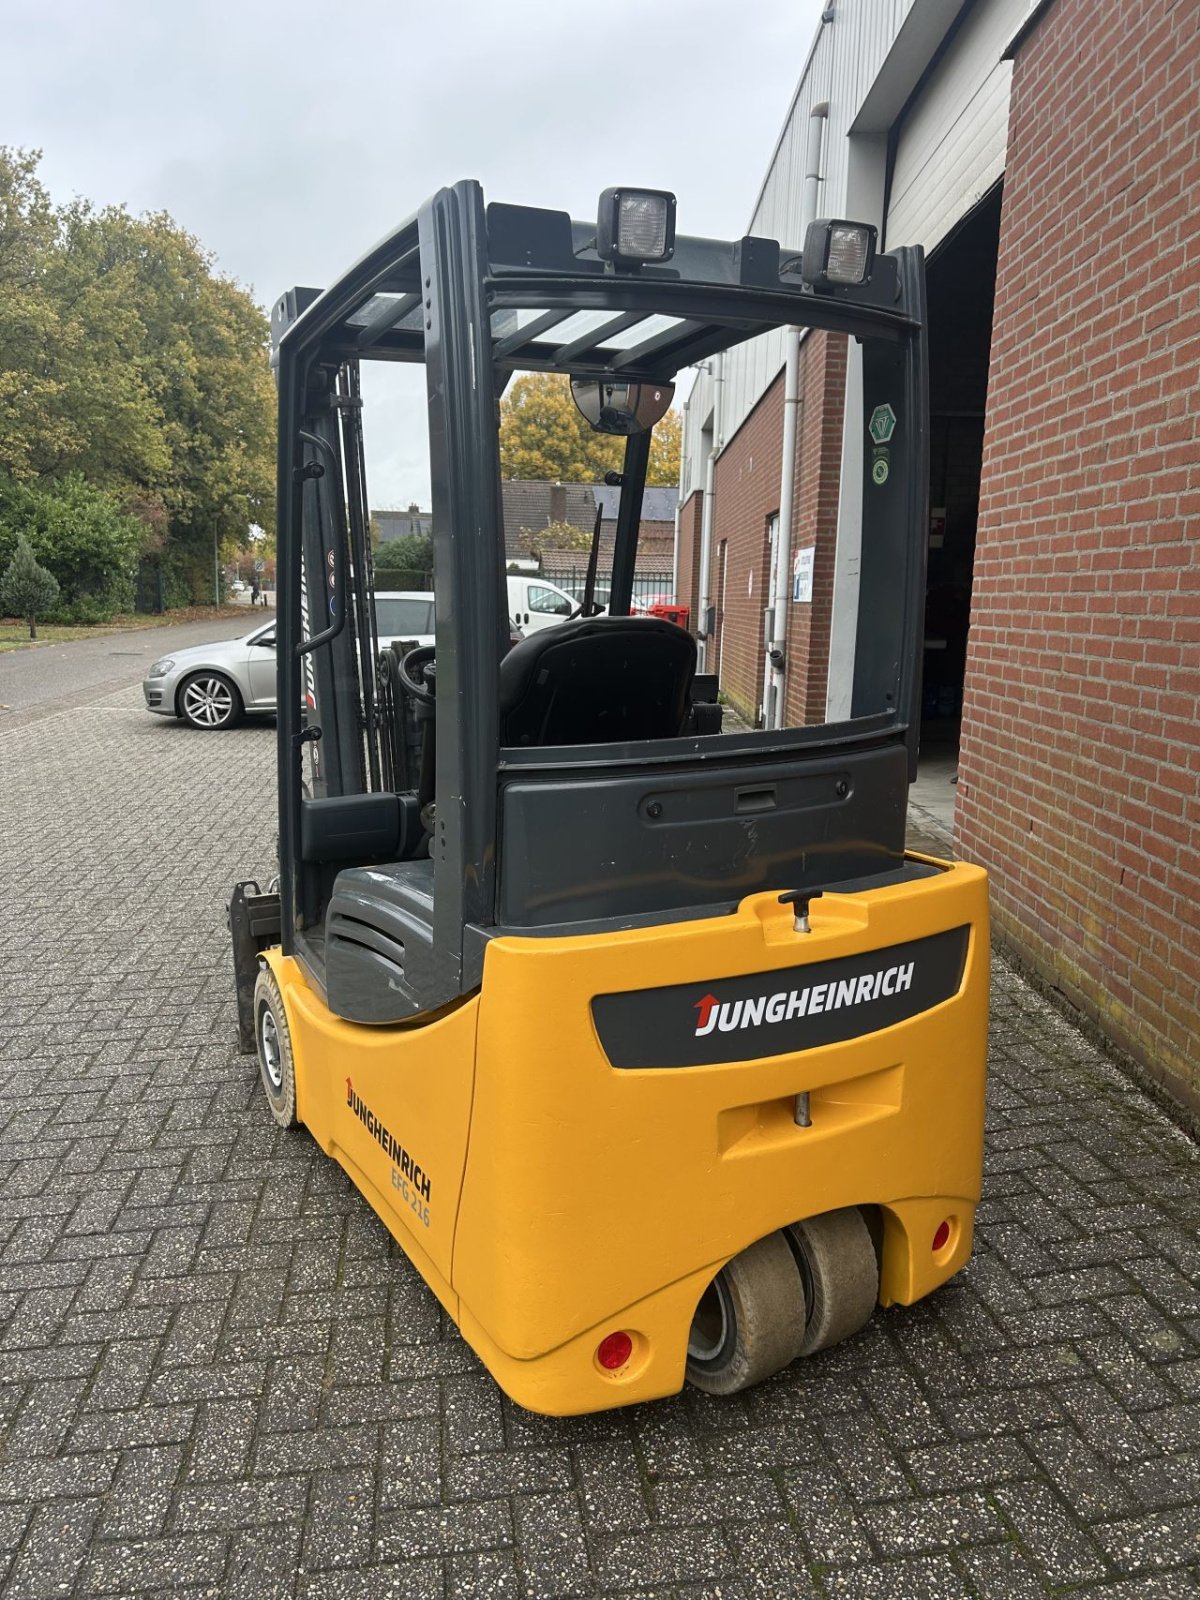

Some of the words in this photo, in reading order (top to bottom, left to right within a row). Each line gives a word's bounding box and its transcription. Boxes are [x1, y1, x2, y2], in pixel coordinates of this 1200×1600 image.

[694, 961, 915, 1037] JUNGHEINRICH
[346, 1088, 432, 1203] JUNGHEINRICH
[391, 1166, 409, 1202] EFG
[410, 1190, 430, 1229] 216
